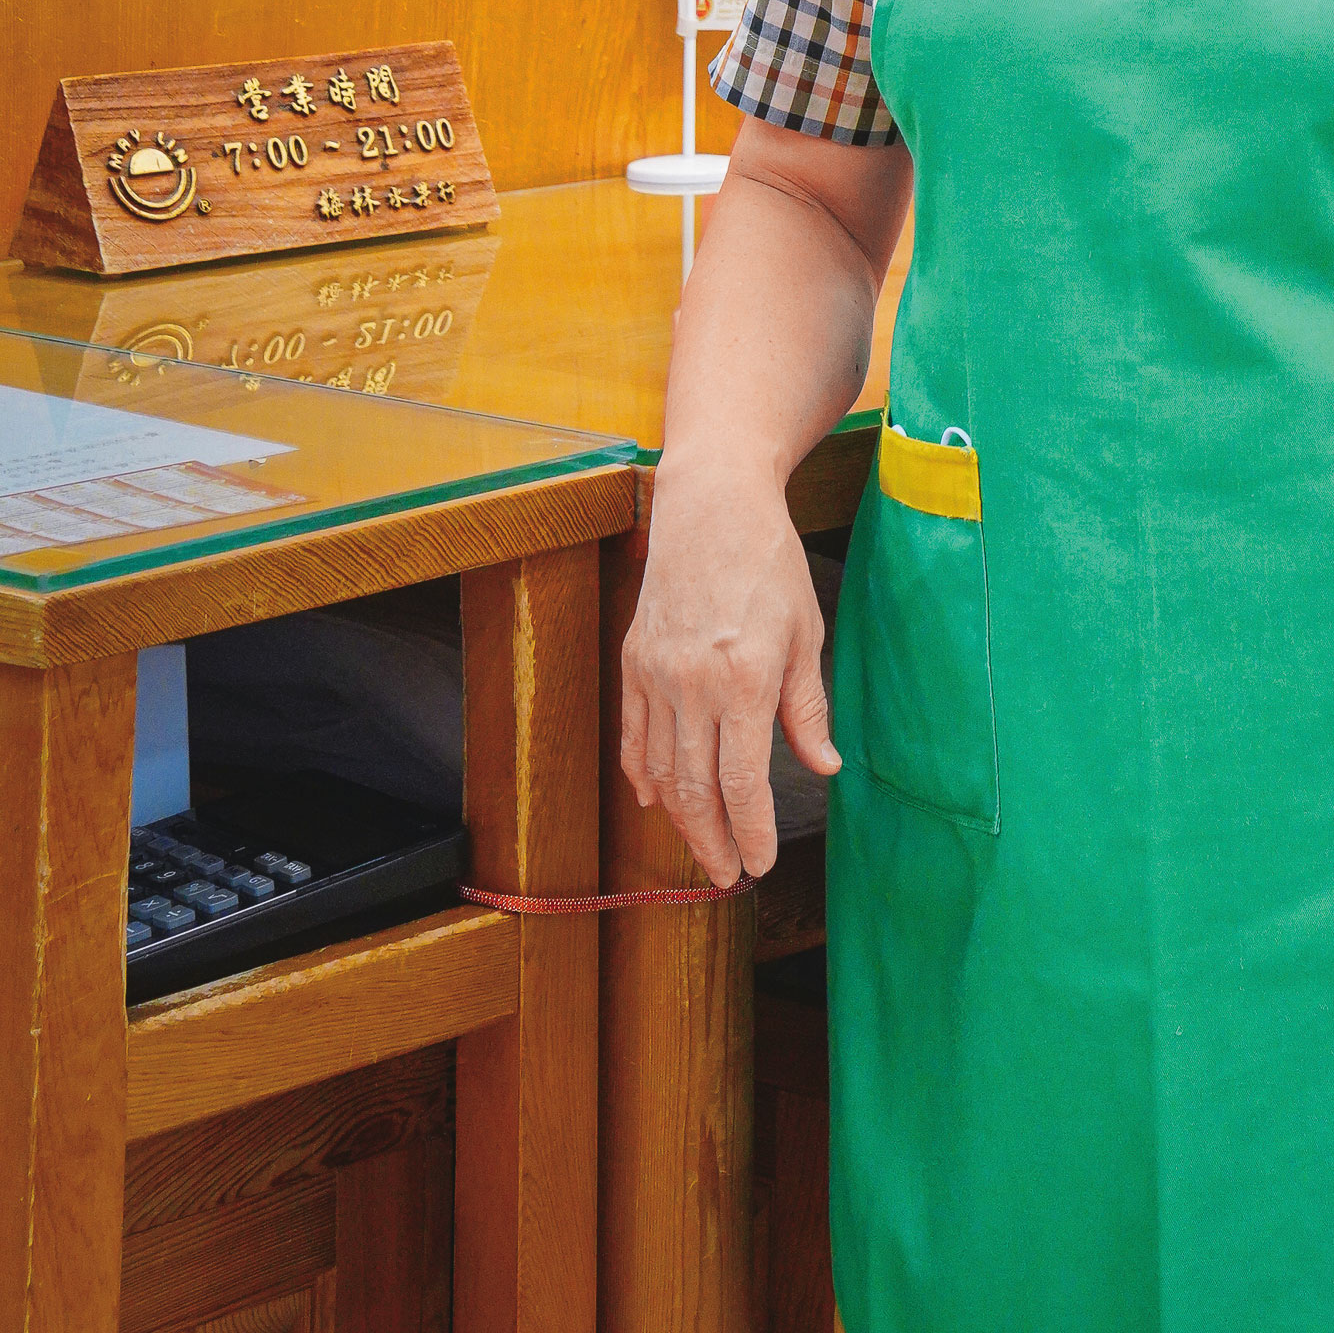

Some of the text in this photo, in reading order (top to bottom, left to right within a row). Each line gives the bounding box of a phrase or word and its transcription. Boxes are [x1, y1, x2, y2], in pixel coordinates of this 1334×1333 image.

[107, 128, 189, 170] MAY LIN
[223, 134, 309, 175] 7:00
[356, 117, 456, 159] 21:00
